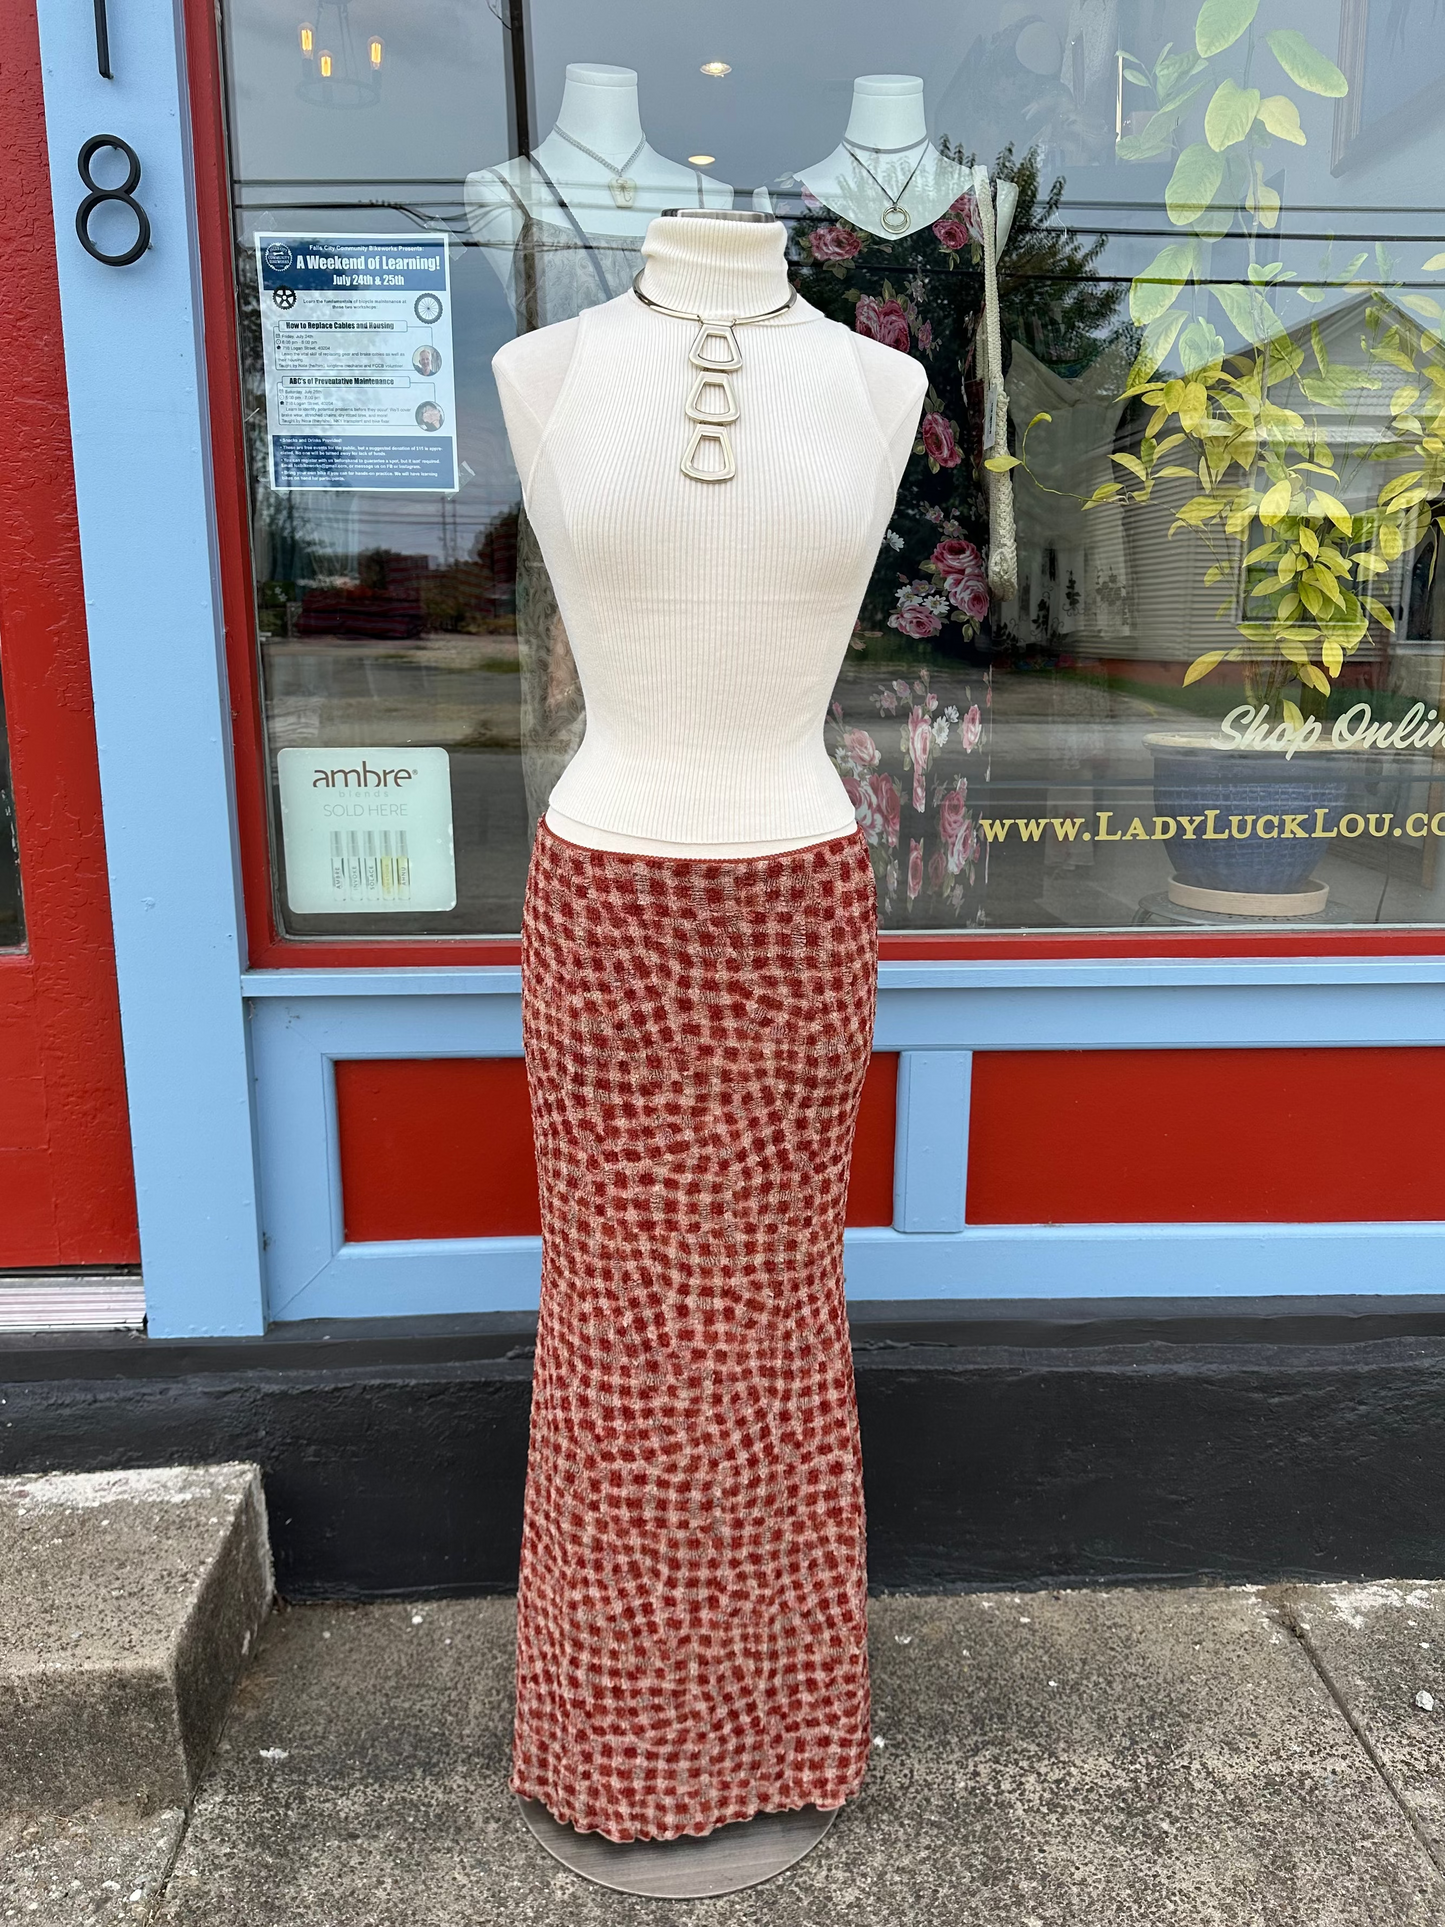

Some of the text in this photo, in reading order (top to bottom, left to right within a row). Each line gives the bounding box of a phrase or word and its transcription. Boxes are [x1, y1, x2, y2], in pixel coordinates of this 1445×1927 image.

[296, 255, 440, 271] A Weekend of Learning!
[332, 274, 404, 286] July 24th & 25th
[308, 322, 332, 330] Replace
[369, 322, 394, 330] Housing
[1210, 704, 1322, 761] Shop
[323, 804, 408, 817] SOLD HERE
